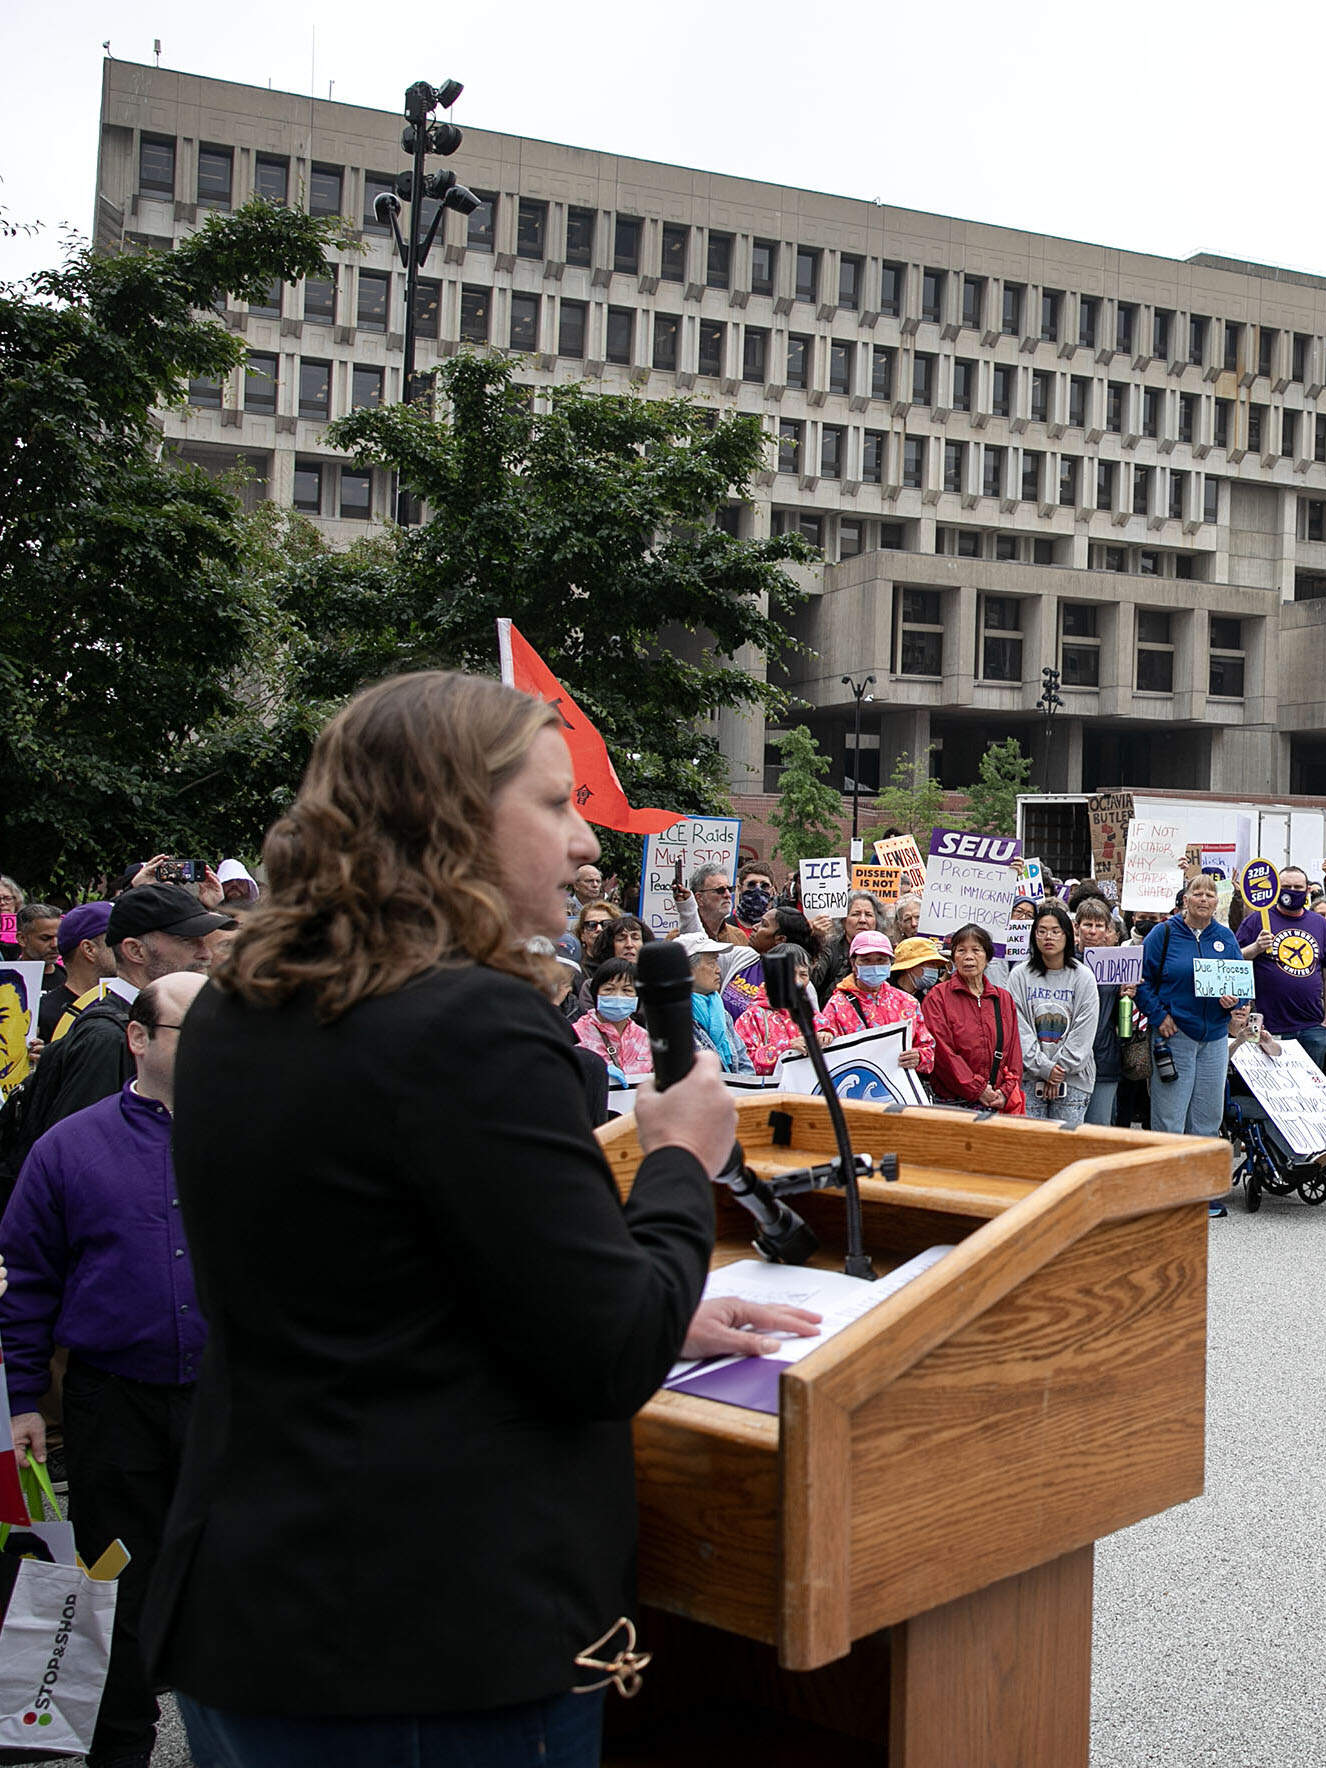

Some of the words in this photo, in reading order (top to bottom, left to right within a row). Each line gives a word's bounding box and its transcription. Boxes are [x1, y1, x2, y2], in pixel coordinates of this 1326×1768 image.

[693, 823, 734, 844] Raids
[1132, 823, 1145, 836] IF
[1151, 826, 1179, 838] NOT
[938, 832, 1017, 862] SEIU
[655, 847, 686, 865] Must
[693, 850, 731, 866] STOP
[883, 846, 920, 868] JEWISH
[805, 862, 841, 880] ICE
[856, 869, 900, 879] DISSENT
[940, 860, 1007, 881] PROTECT
[1247, 866, 1270, 879] 32BJ
[872, 880, 894, 888] NOT
[930, 882, 953, 894] OUR
[803, 891, 848, 910] GESTAPO
[1251, 889, 1273, 903] SEIU
[928, 900, 1011, 926] NEIGHBORS!
[1086, 949, 1141, 983] SOLIDARITY
[1194, 959, 1212, 973] Due
[1216, 959, 1250, 975] Process
[1283, 965, 1310, 976] UNITED
[1027, 987, 1051, 1001] LAKE
[1195, 979, 1215, 996] Rule
[1219, 982, 1227, 996] of
[1231, 979, 1254, 997] Law!
